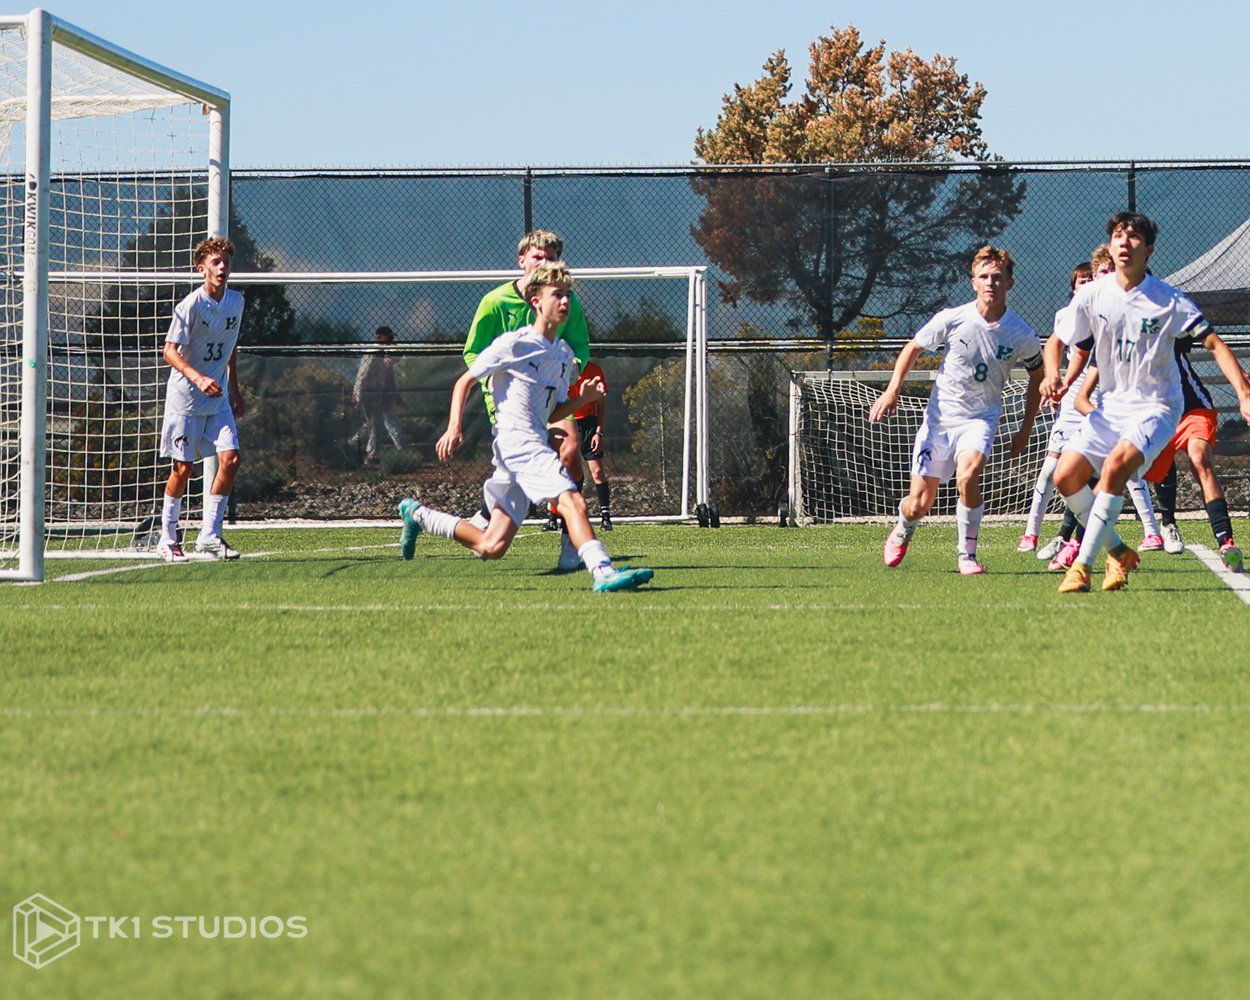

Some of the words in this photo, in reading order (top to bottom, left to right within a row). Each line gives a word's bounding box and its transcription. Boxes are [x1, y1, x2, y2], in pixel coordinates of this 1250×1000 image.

[203, 342, 225, 362] 33
[1117, 338, 1136, 363] 17
[974, 362, 989, 383] 8
